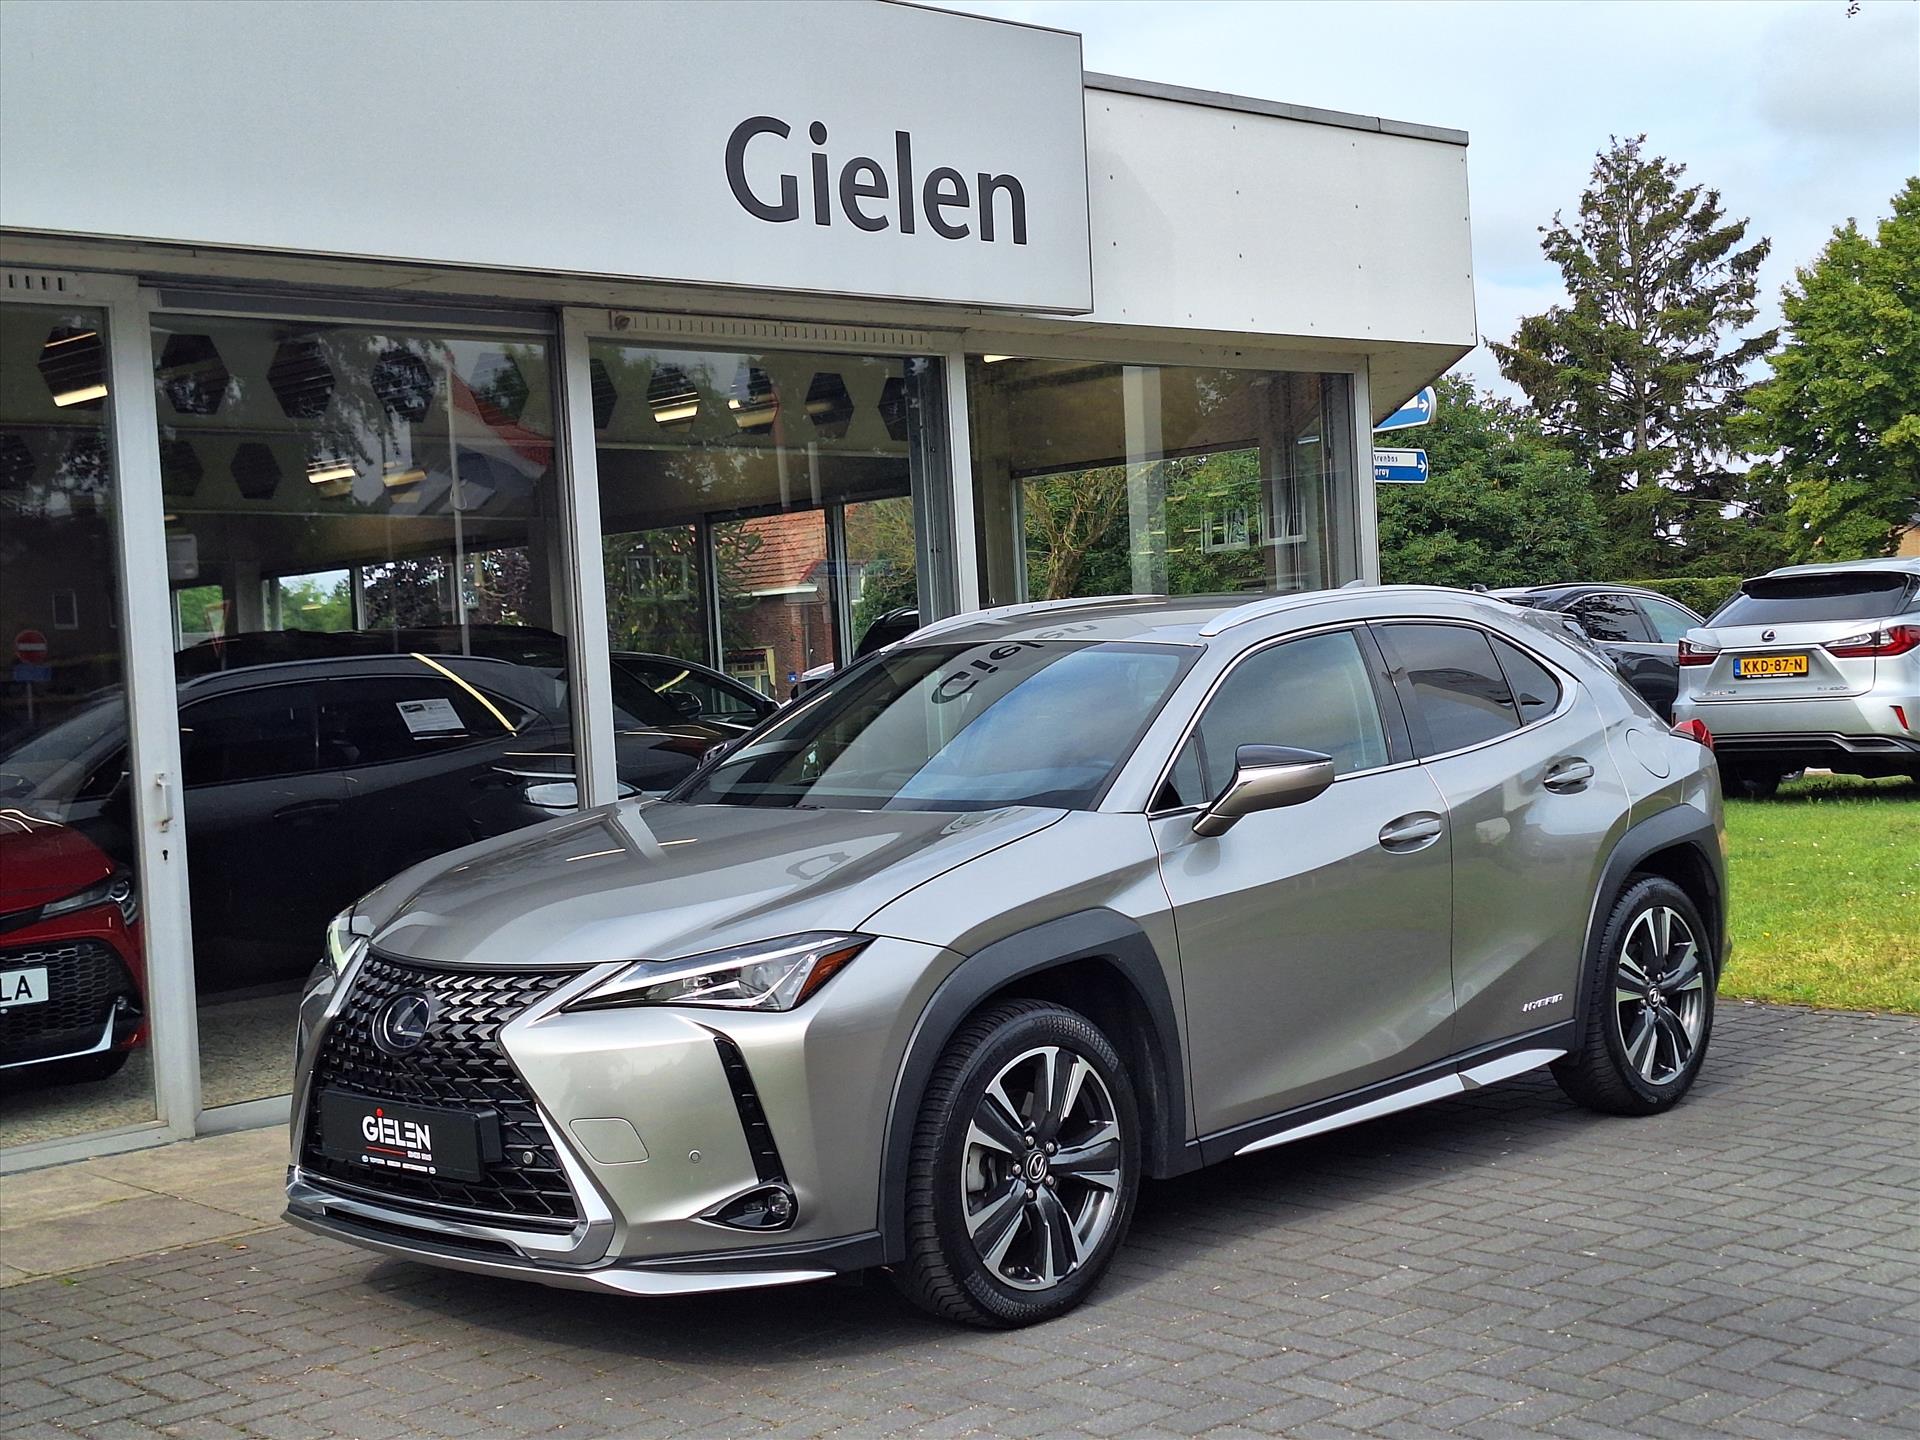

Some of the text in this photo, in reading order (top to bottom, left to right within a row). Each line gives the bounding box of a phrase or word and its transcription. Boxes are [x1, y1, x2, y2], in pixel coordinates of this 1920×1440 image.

[724, 115, 1028, 246] Gielen
[1743, 658, 1803, 673] KKD-87-N
[362, 1108, 432, 1152] GIELEN
